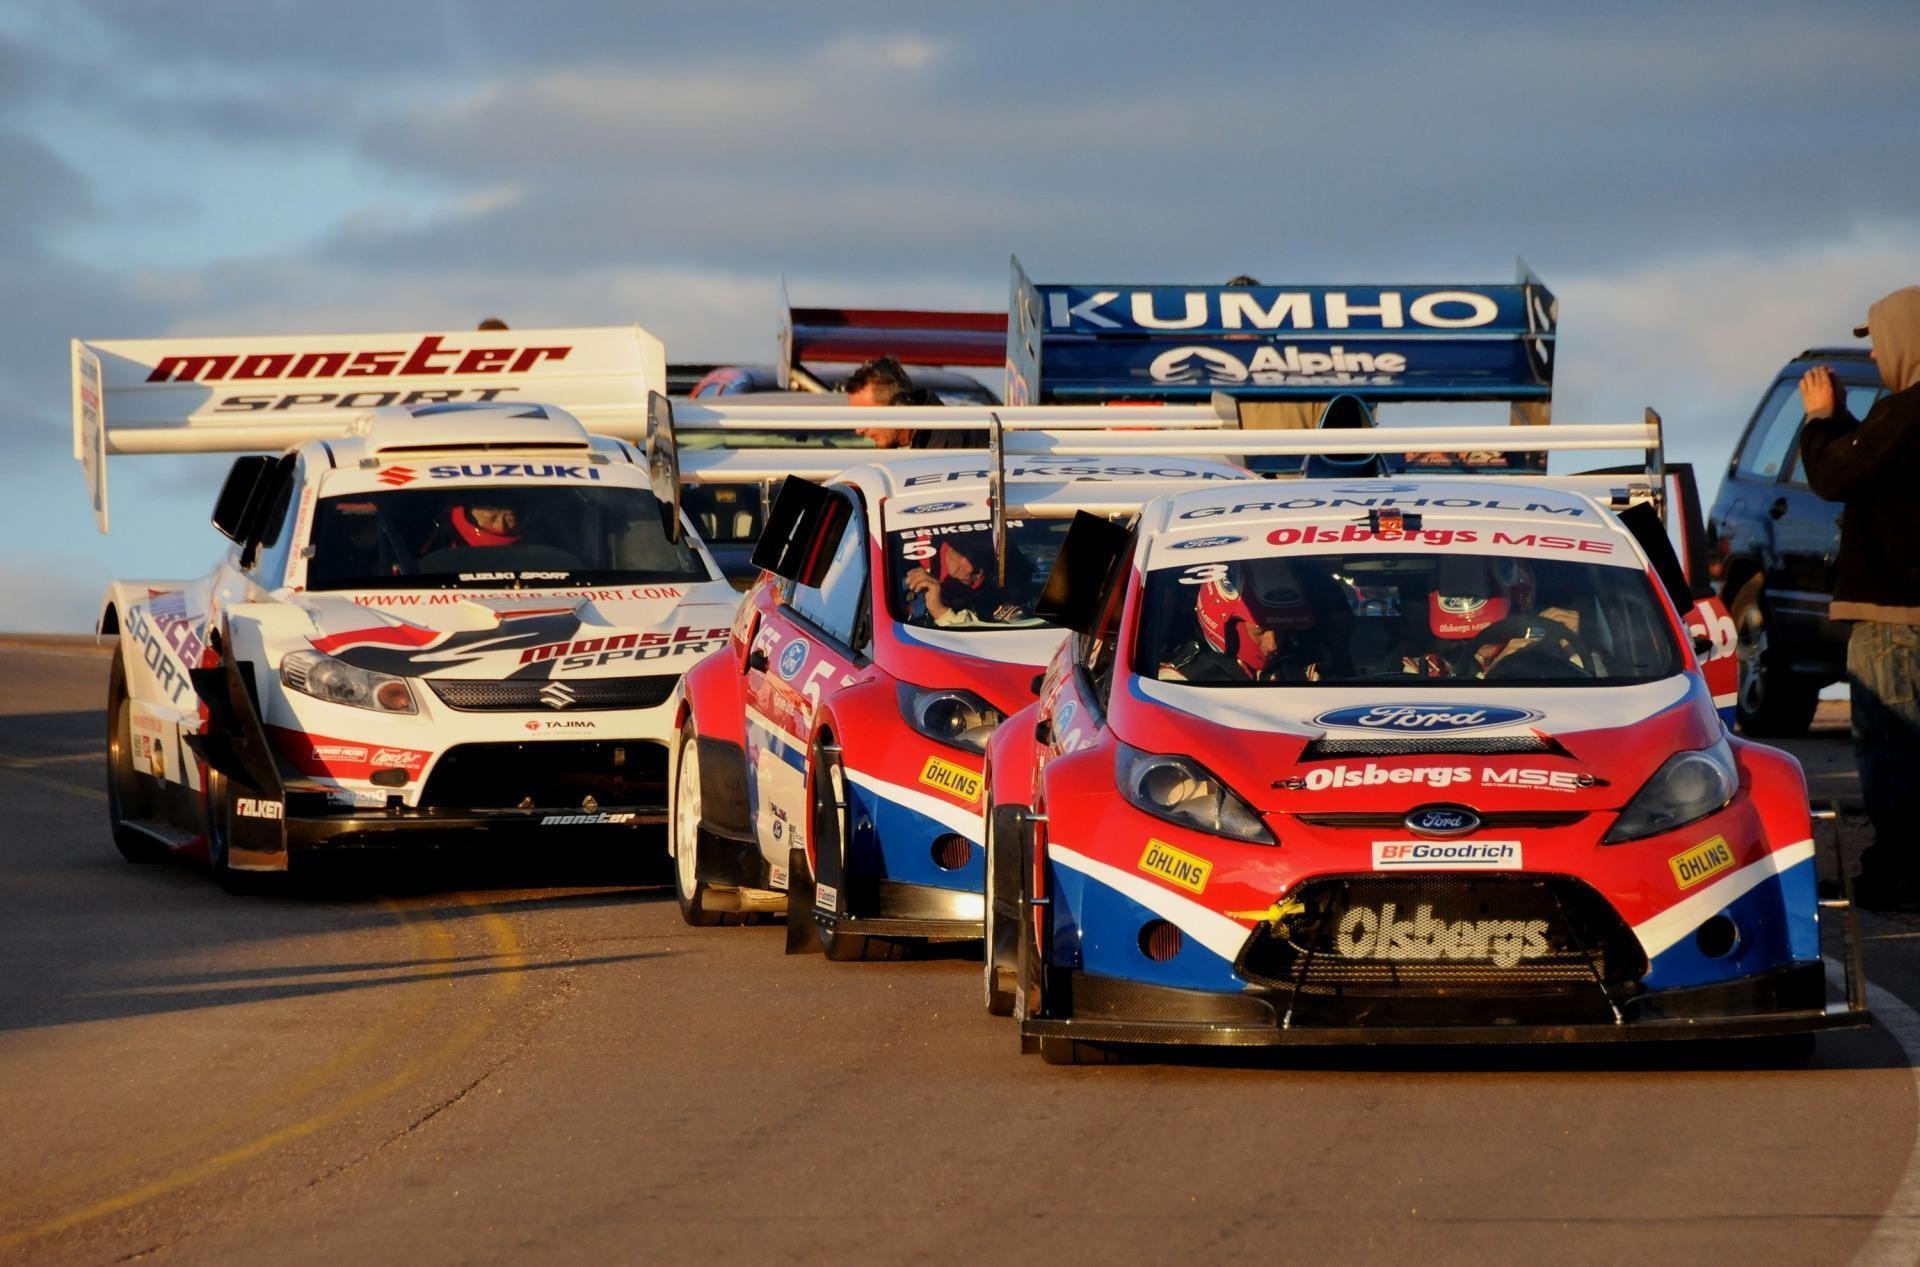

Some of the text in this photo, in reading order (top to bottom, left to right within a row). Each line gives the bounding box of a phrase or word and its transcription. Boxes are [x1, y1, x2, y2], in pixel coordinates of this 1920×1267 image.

[1048, 291, 1499, 329] KUMHO
[145, 336, 573, 383] monster
[1249, 346, 1407, 376] Alpine
[213, 388, 519, 413] SPORT
[429, 464, 600, 481] SUZUKI
[902, 540, 937, 561] 5
[1184, 536, 1229, 549] Ford
[1266, 525, 1615, 553] Olsbergs MSE
[459, 571, 570, 582] SUZUKI SPORT
[1178, 564, 1229, 585] 3
[126, 606, 190, 704] SPORT
[519, 626, 732, 665] monste
[802, 659, 836, 730] 5
[545, 720, 596, 729] TAJIMA
[1358, 705, 1488, 728] Ford
[925, 759, 979, 798] ÖHLINS
[1304, 763, 1578, 790] Olsbergs MSE
[236, 798, 284, 820] FALKEN
[540, 812, 636, 826] monster
[1422, 812, 1463, 828] Ford
[1145, 843, 1206, 885] ÖHLINS
[1381, 843, 1515, 860] BFGoodrich
[1675, 843, 1730, 883] ÖHLINS
[1336, 903, 1550, 968] Olsbergs
